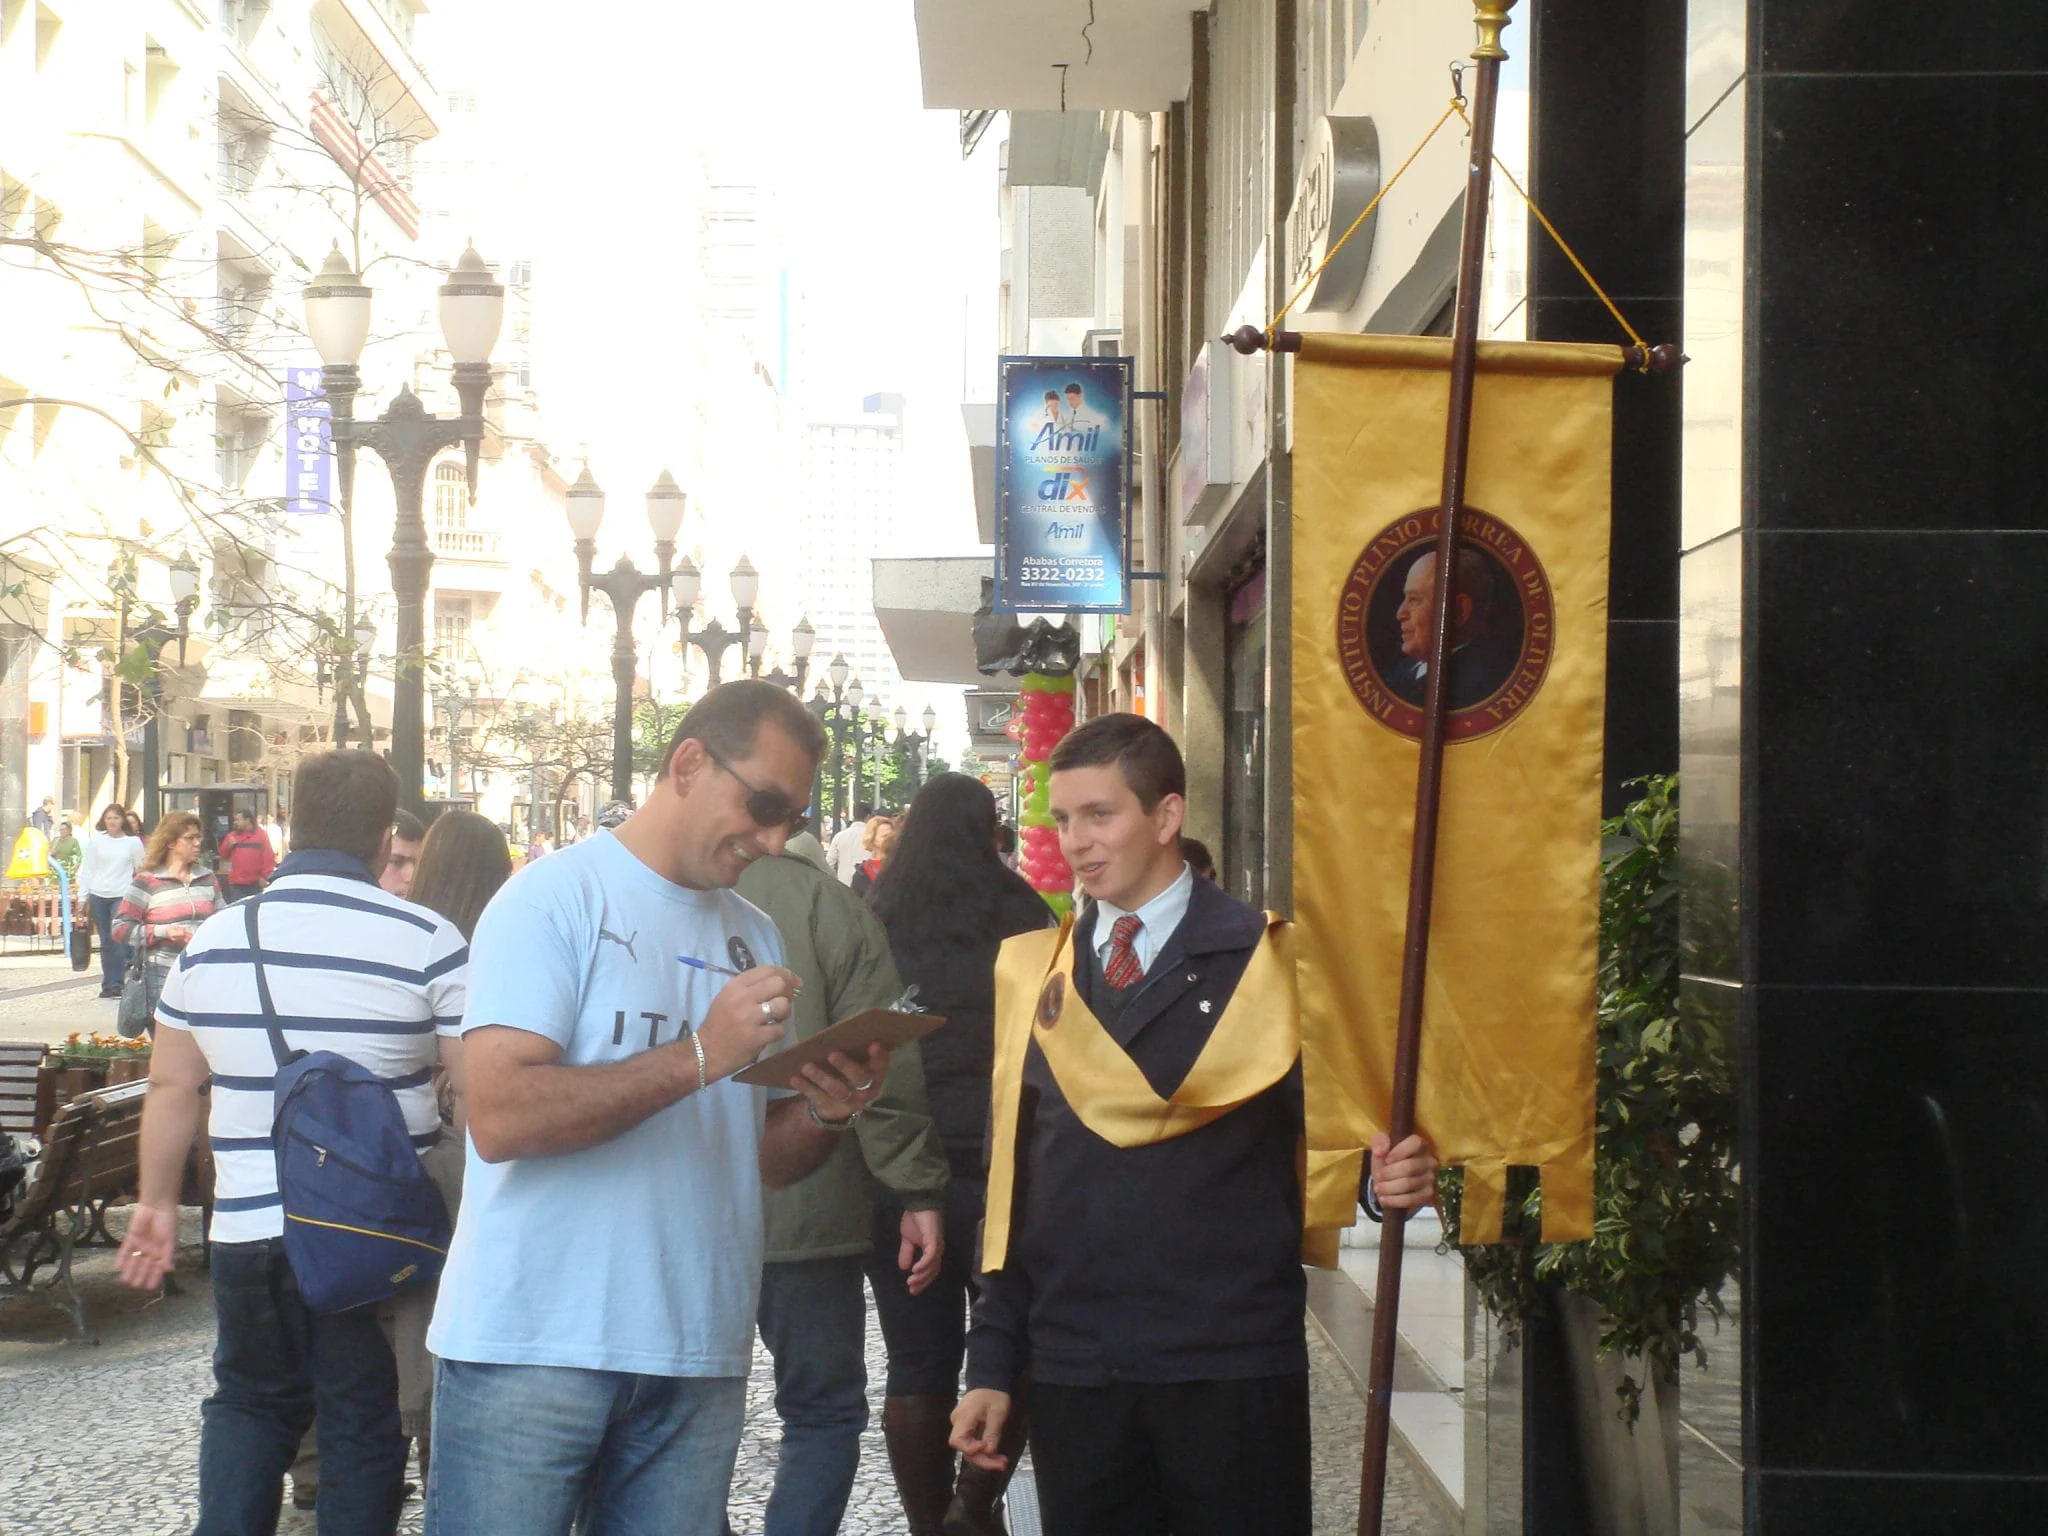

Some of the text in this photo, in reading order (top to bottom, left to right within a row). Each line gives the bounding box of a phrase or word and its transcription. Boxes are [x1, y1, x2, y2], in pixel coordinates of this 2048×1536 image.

[1029, 421, 1101, 452] Amil
[297, 416, 321, 510] HOTEL
[1024, 455, 1058, 464] PLANOS
[1060, 455, 1072, 464] DE
[1038, 472, 1088, 500] dix
[1020, 504, 1106, 513] CENTRAL DE VENDAS
[1045, 521, 1084, 539] Amil
[1022, 556, 1103, 566] Ababas Corretora
[1021, 567, 1105, 581] 3322-0232
[1343, 513, 1548, 719] INSTITUTO PLINIO CRREA DE OLIVEIRA
